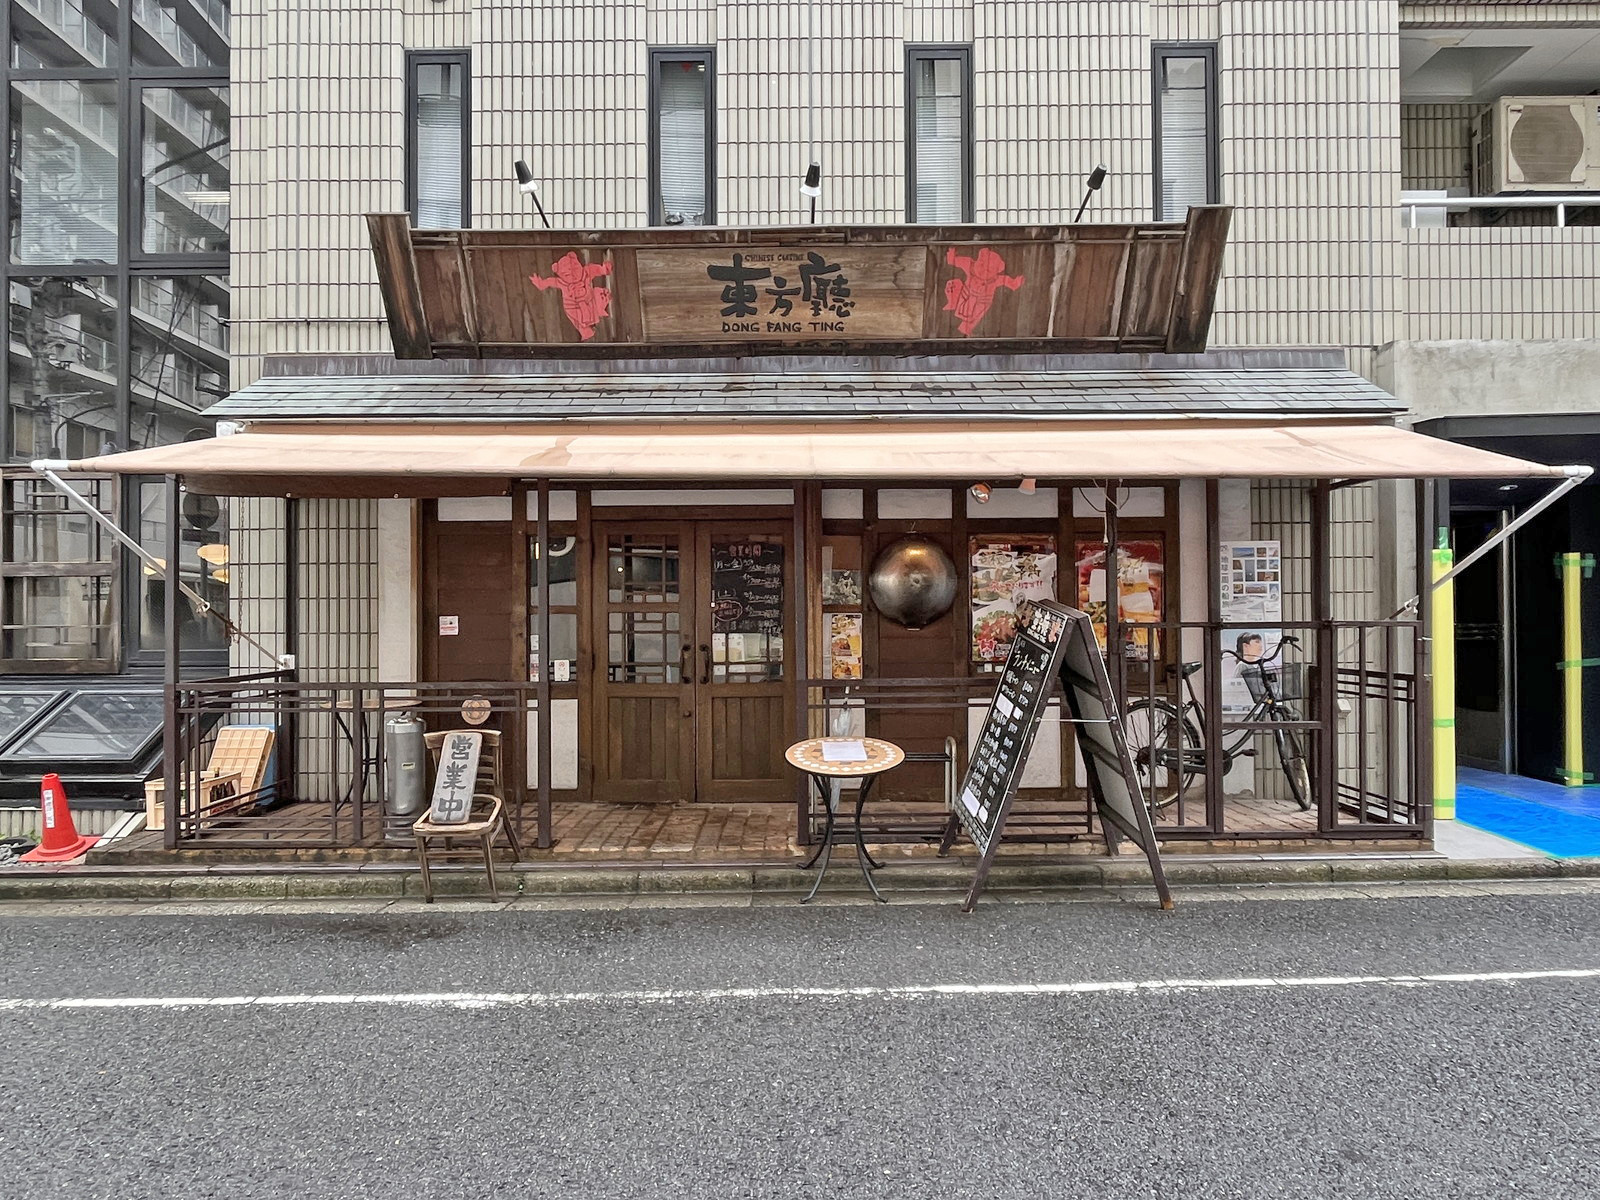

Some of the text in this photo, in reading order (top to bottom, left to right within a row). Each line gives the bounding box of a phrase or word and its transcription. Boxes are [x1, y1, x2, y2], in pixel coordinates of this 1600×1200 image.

[721, 321, 845, 333] DONG FANG TING
[438, 734, 473, 821] 営業中
